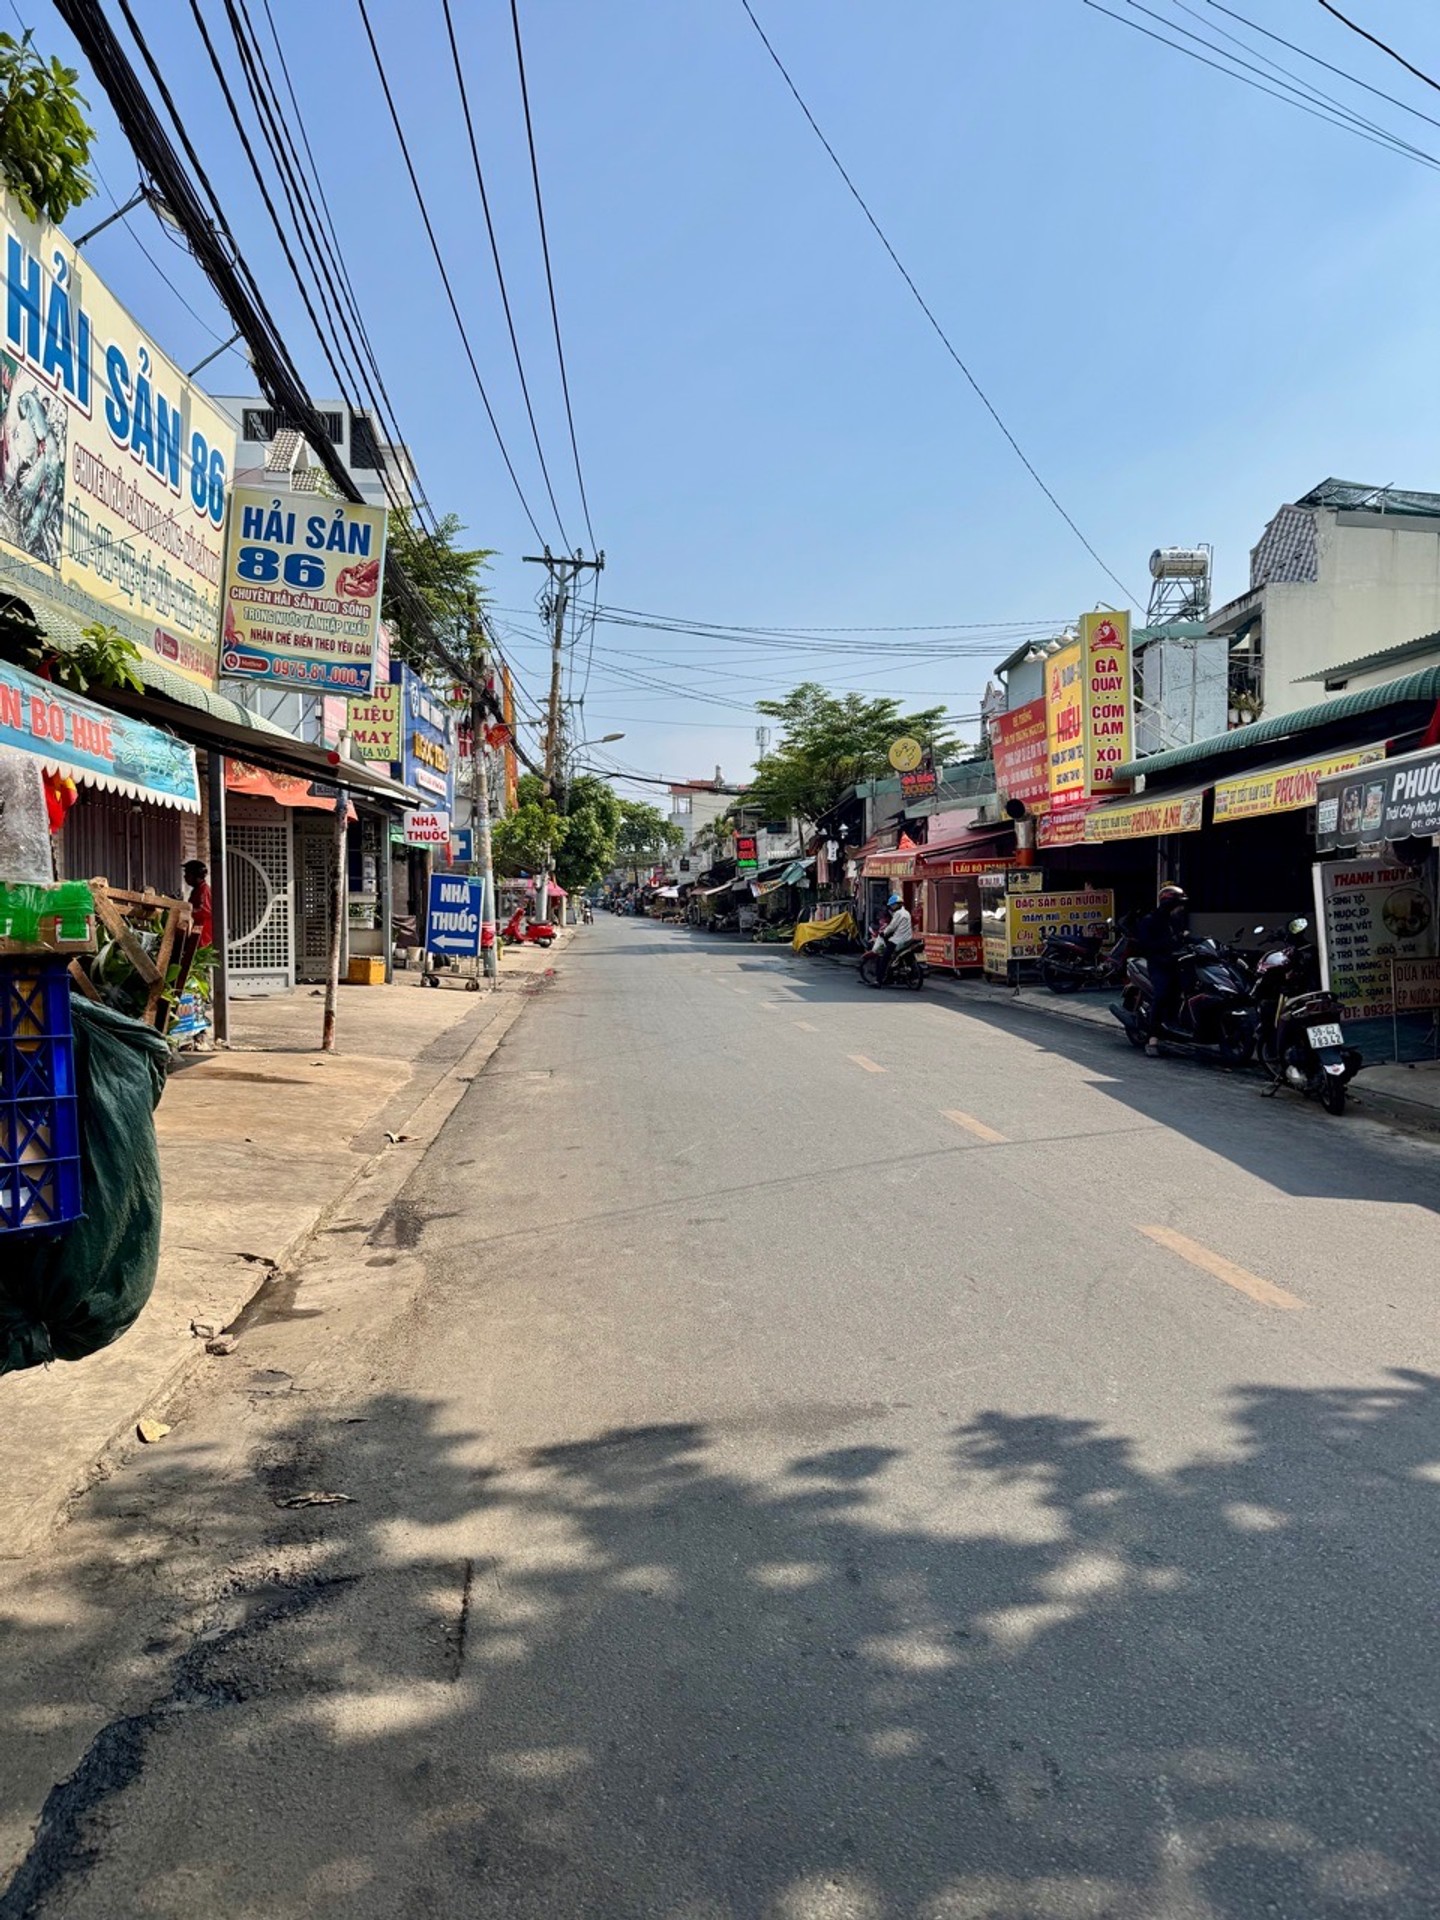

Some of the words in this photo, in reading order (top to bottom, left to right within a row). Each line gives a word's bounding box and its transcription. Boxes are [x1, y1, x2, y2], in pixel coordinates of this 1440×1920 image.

[6, 233, 91, 408] HẢI
[104, 345, 182, 490] SẢN
[190, 431, 225, 524] 86
[242, 499, 296, 545] HẢI
[305, 508, 372, 557] SẢN
[237, 546, 326, 590] 86
[231, 586, 272, 603] CHUYÊN
[274, 589, 291, 607] HẢI
[293, 593, 315, 611] SẢN
[317, 599, 340, 614] TƯƠI
[341, 600, 371, 618] SỐNG
[243, 606, 275, 623] TRONG
[303, 613, 316, 629] VÀ
[316, 617, 344, 635] NHẬP
[250, 628, 273, 645] NHẬN
[275, 629, 292, 644] CHẾ
[293, 631, 313, 648] BIẾN
[315, 636, 336, 651] THEO
[337, 637, 352, 654] YÊU
[272, 658, 370, 688] 0975.81.000.7
[1095, 655, 1119, 673] GÀ
[1091, 676, 1123, 692] QUAY
[353, 704, 395, 725] LIỆU
[1092, 704, 1125, 719] CƠM
[30, 694, 66, 744] BÒ
[72, 716, 115, 762] HUẾ
[353, 730, 393, 745] MAY
[1093, 721, 1123, 736] LAM
[1096, 745, 1122, 762] XÔI
[411, 814, 438, 827] NHÀ
[1162, 805, 1182, 829] ANH
[407, 826, 448, 841] THUỐC
[1334, 872, 1374, 887] THANH
[440, 881, 471, 904] NHÀ
[1333, 896, 1351, 906] SINH
[431, 907, 478, 933] THUỐC
